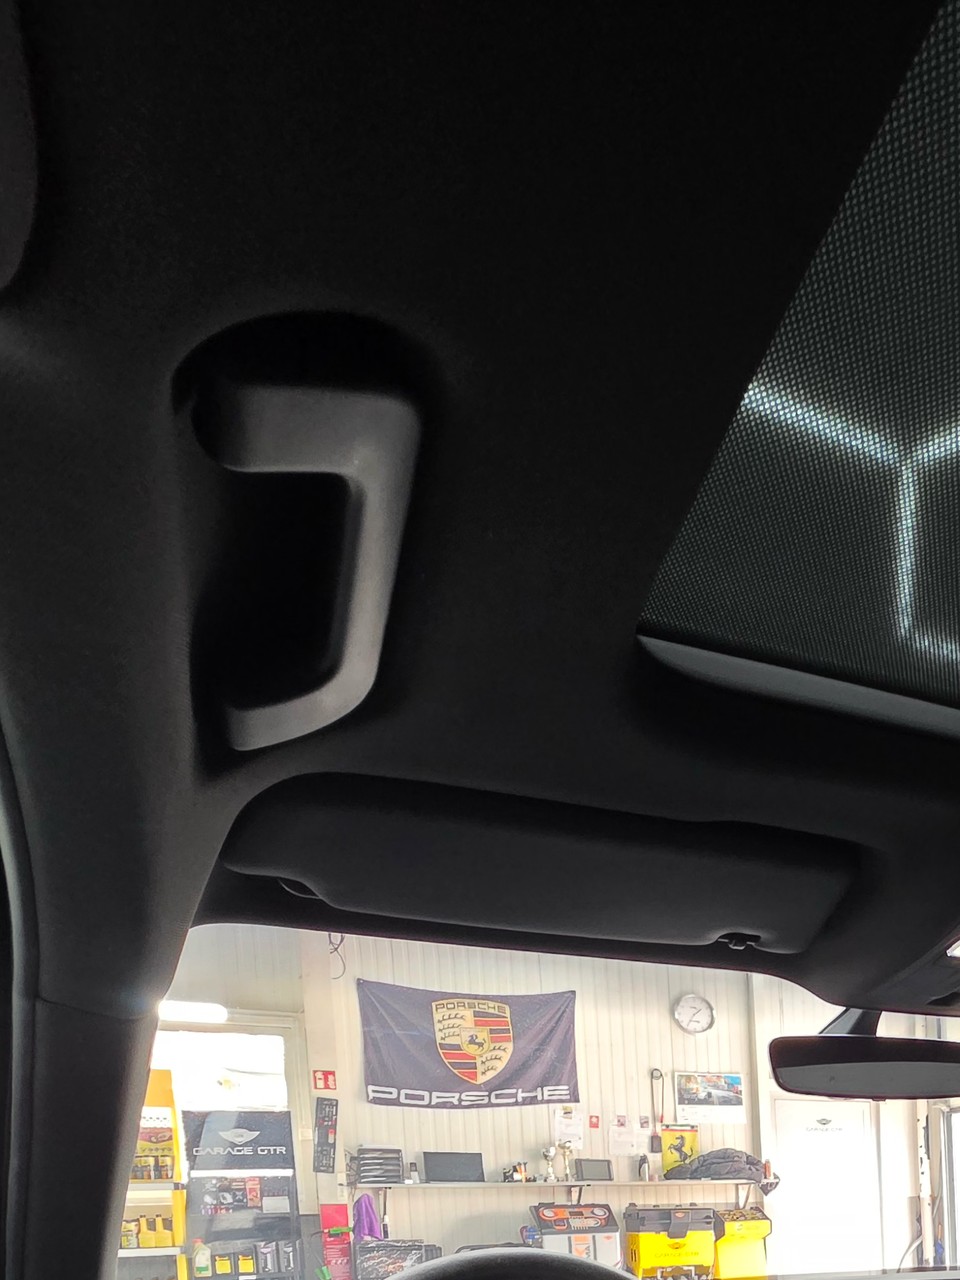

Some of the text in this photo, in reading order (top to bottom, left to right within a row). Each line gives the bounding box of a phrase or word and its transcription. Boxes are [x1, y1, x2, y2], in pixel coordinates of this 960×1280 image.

[435, 1002, 507, 1014] PORSCHE
[367, 1085, 570, 1106] PORSCHE
[193, 1146, 286, 1156] GARAGE GTR
